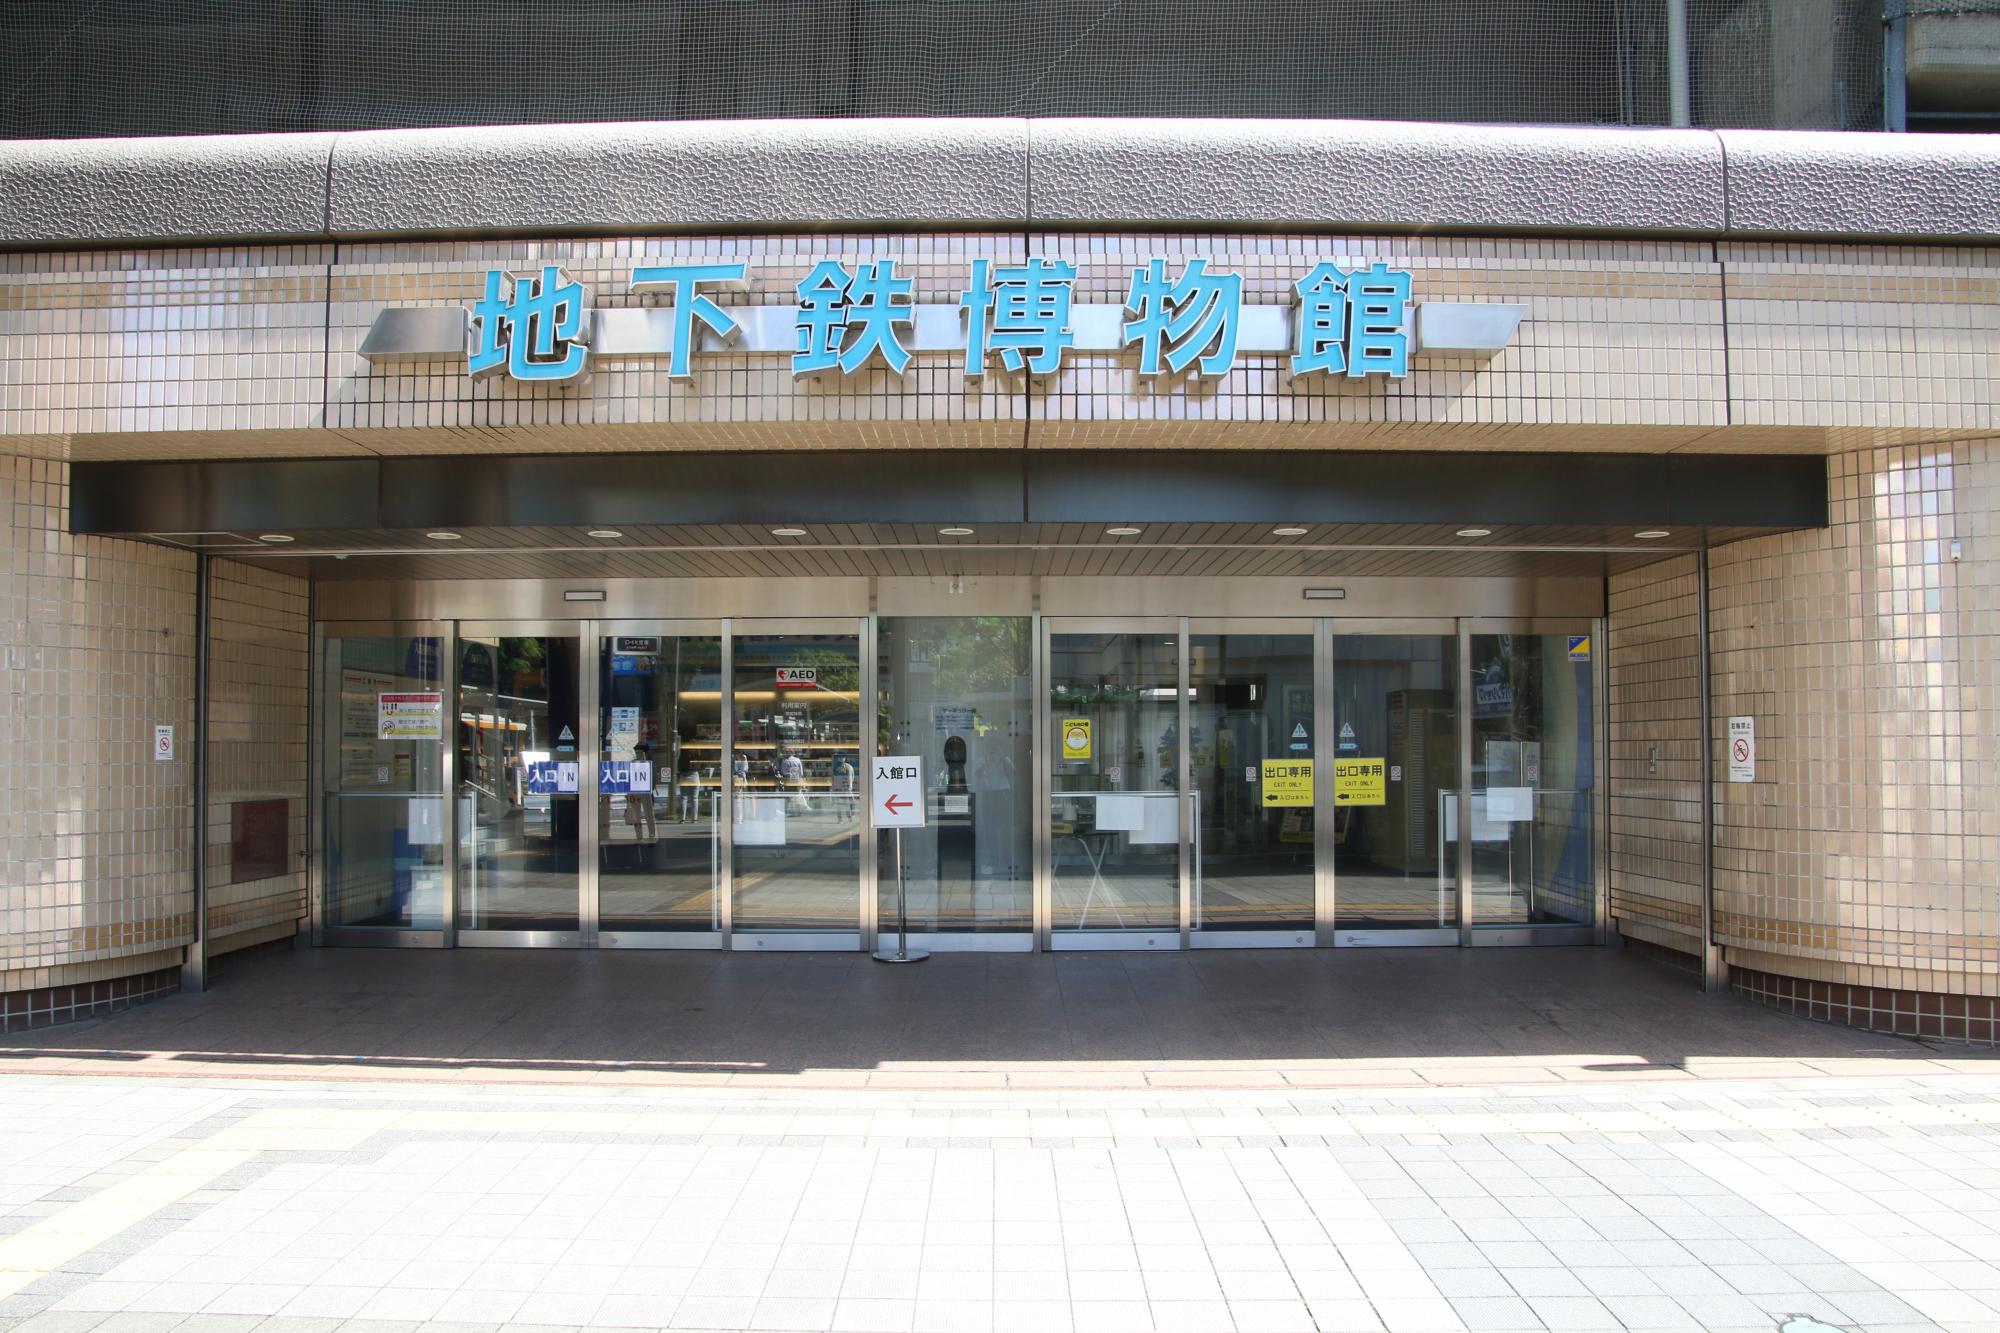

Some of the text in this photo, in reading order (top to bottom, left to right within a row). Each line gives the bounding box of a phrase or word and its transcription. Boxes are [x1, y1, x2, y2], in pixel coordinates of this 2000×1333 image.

[468, 256, 1414, 381] 地下鉄博物館
[789, 670, 815, 679] AED
[529, 769, 575, 784] 入口 IN
[601, 769, 647, 783] 入口 IN
[876, 766, 917, 780] 入館口
[1264, 766, 1312, 778] 出口専用
[1336, 765, 1382, 777] 出口専用
